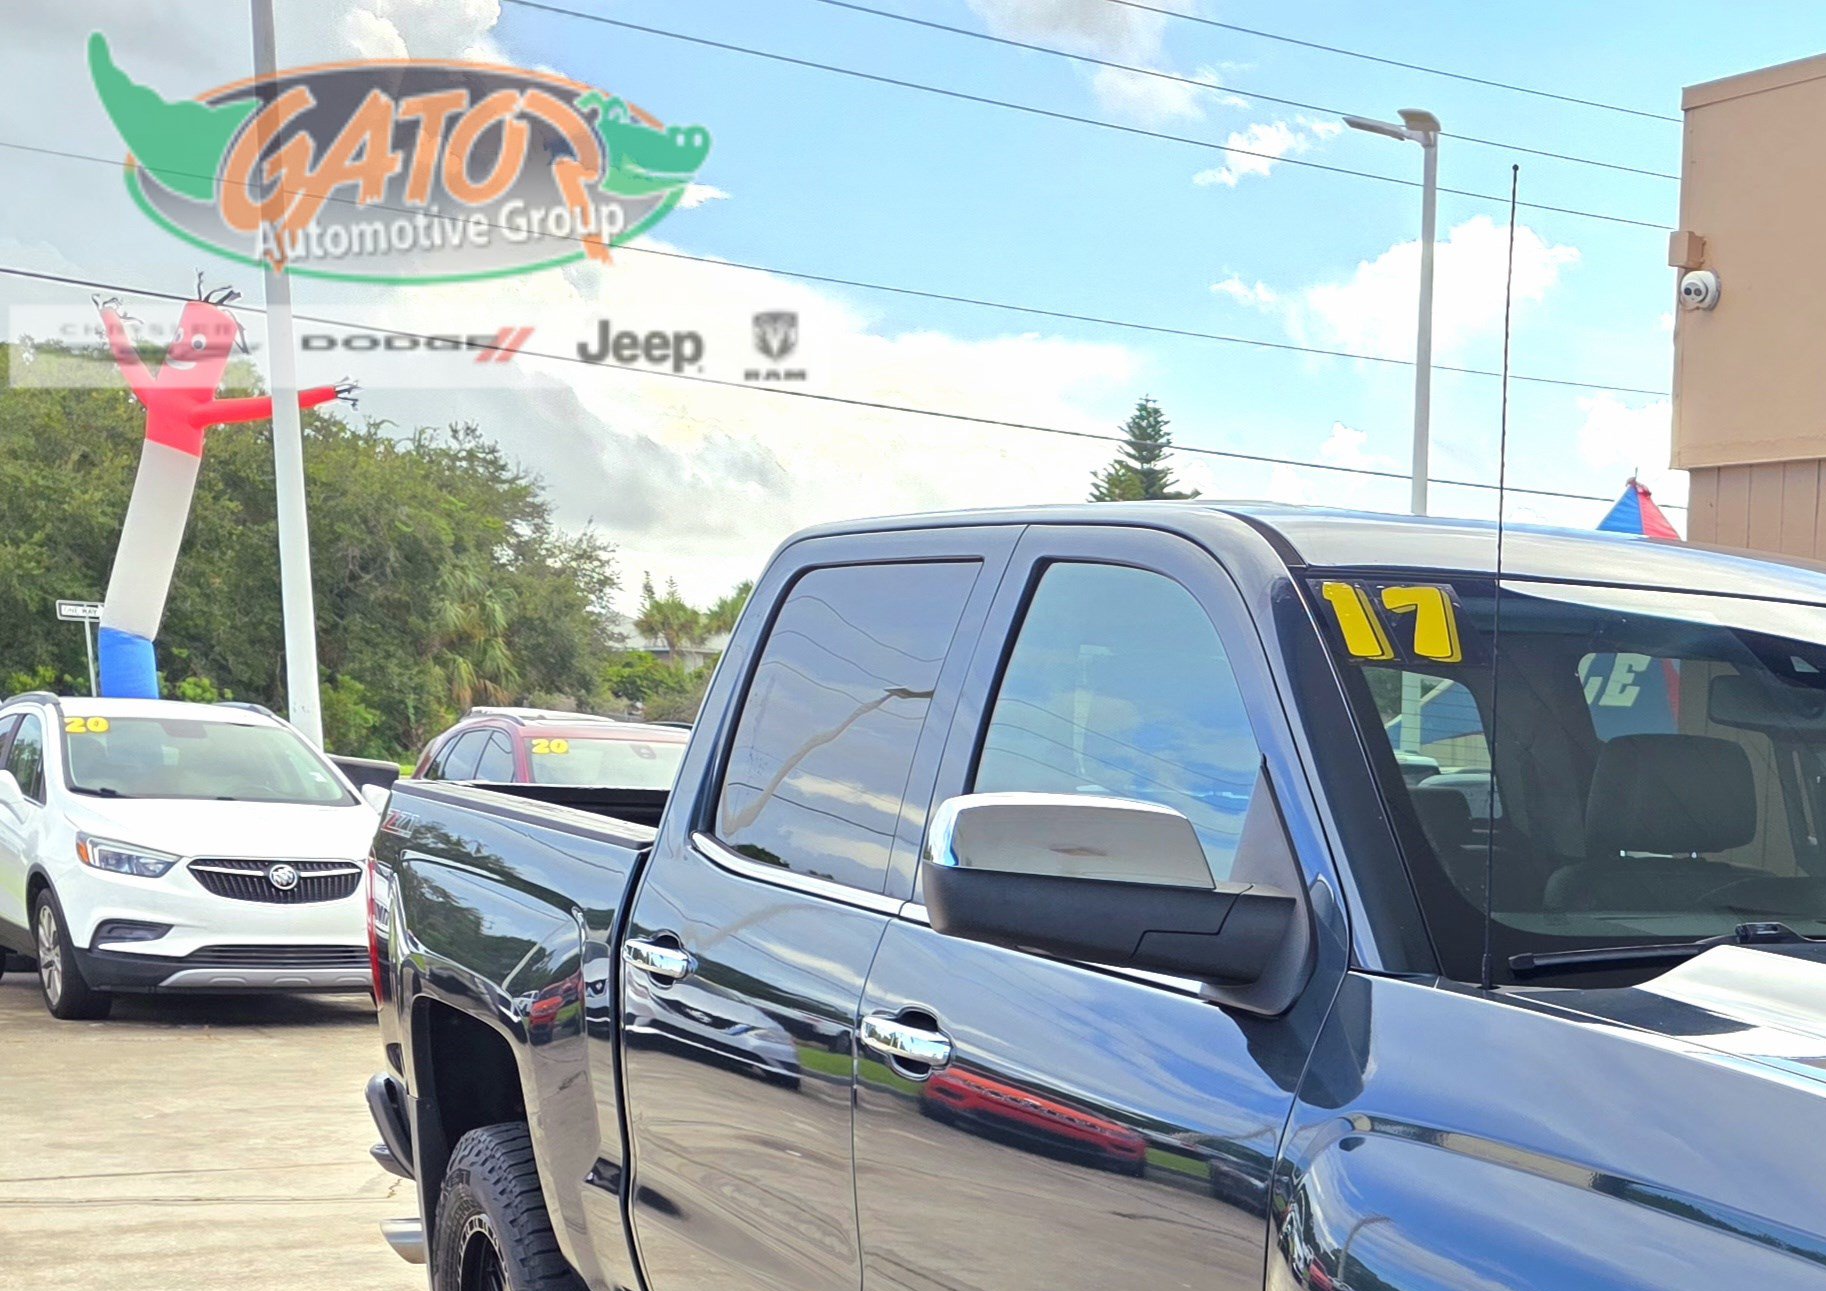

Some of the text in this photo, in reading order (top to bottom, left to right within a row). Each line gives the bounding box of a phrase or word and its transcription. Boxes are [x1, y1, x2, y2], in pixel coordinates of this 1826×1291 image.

[1322, 582, 1462, 663] 17
[64, 716, 109, 732] 20
[532, 738, 569, 754] 20
